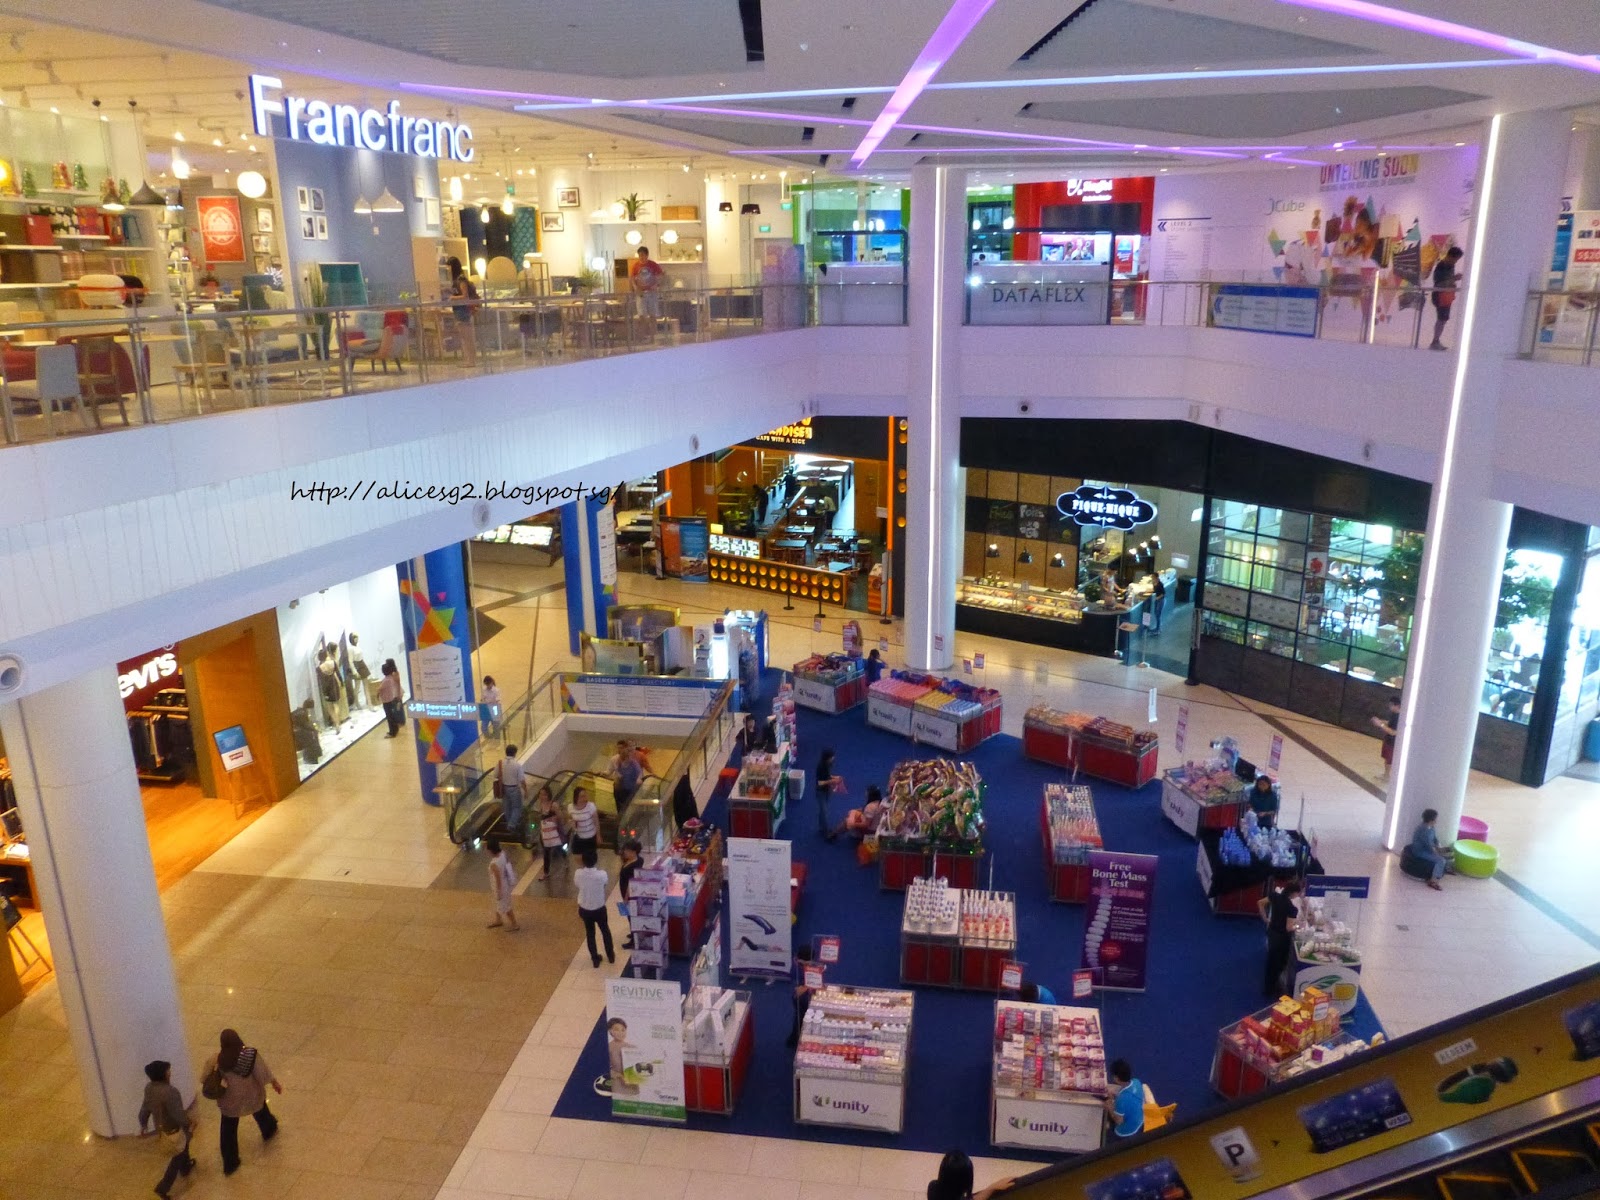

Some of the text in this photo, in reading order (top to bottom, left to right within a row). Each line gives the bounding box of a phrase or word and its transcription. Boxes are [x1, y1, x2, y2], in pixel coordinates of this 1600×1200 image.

[248, 74, 474, 163] Francfranc
[993, 287, 1086, 303] DATAFLEX
[118, 652, 177, 699] evi's
[1109, 861, 1132, 871] Free
[1092, 868, 1148, 881] Bone Mass
[1109, 878, 1129, 888] Test
[612, 985, 663, 998] REVITIVE
[833, 1100, 870, 1115] unity
[1029, 1121, 1069, 1136] unity
[1224, 1143, 1245, 1167] P
